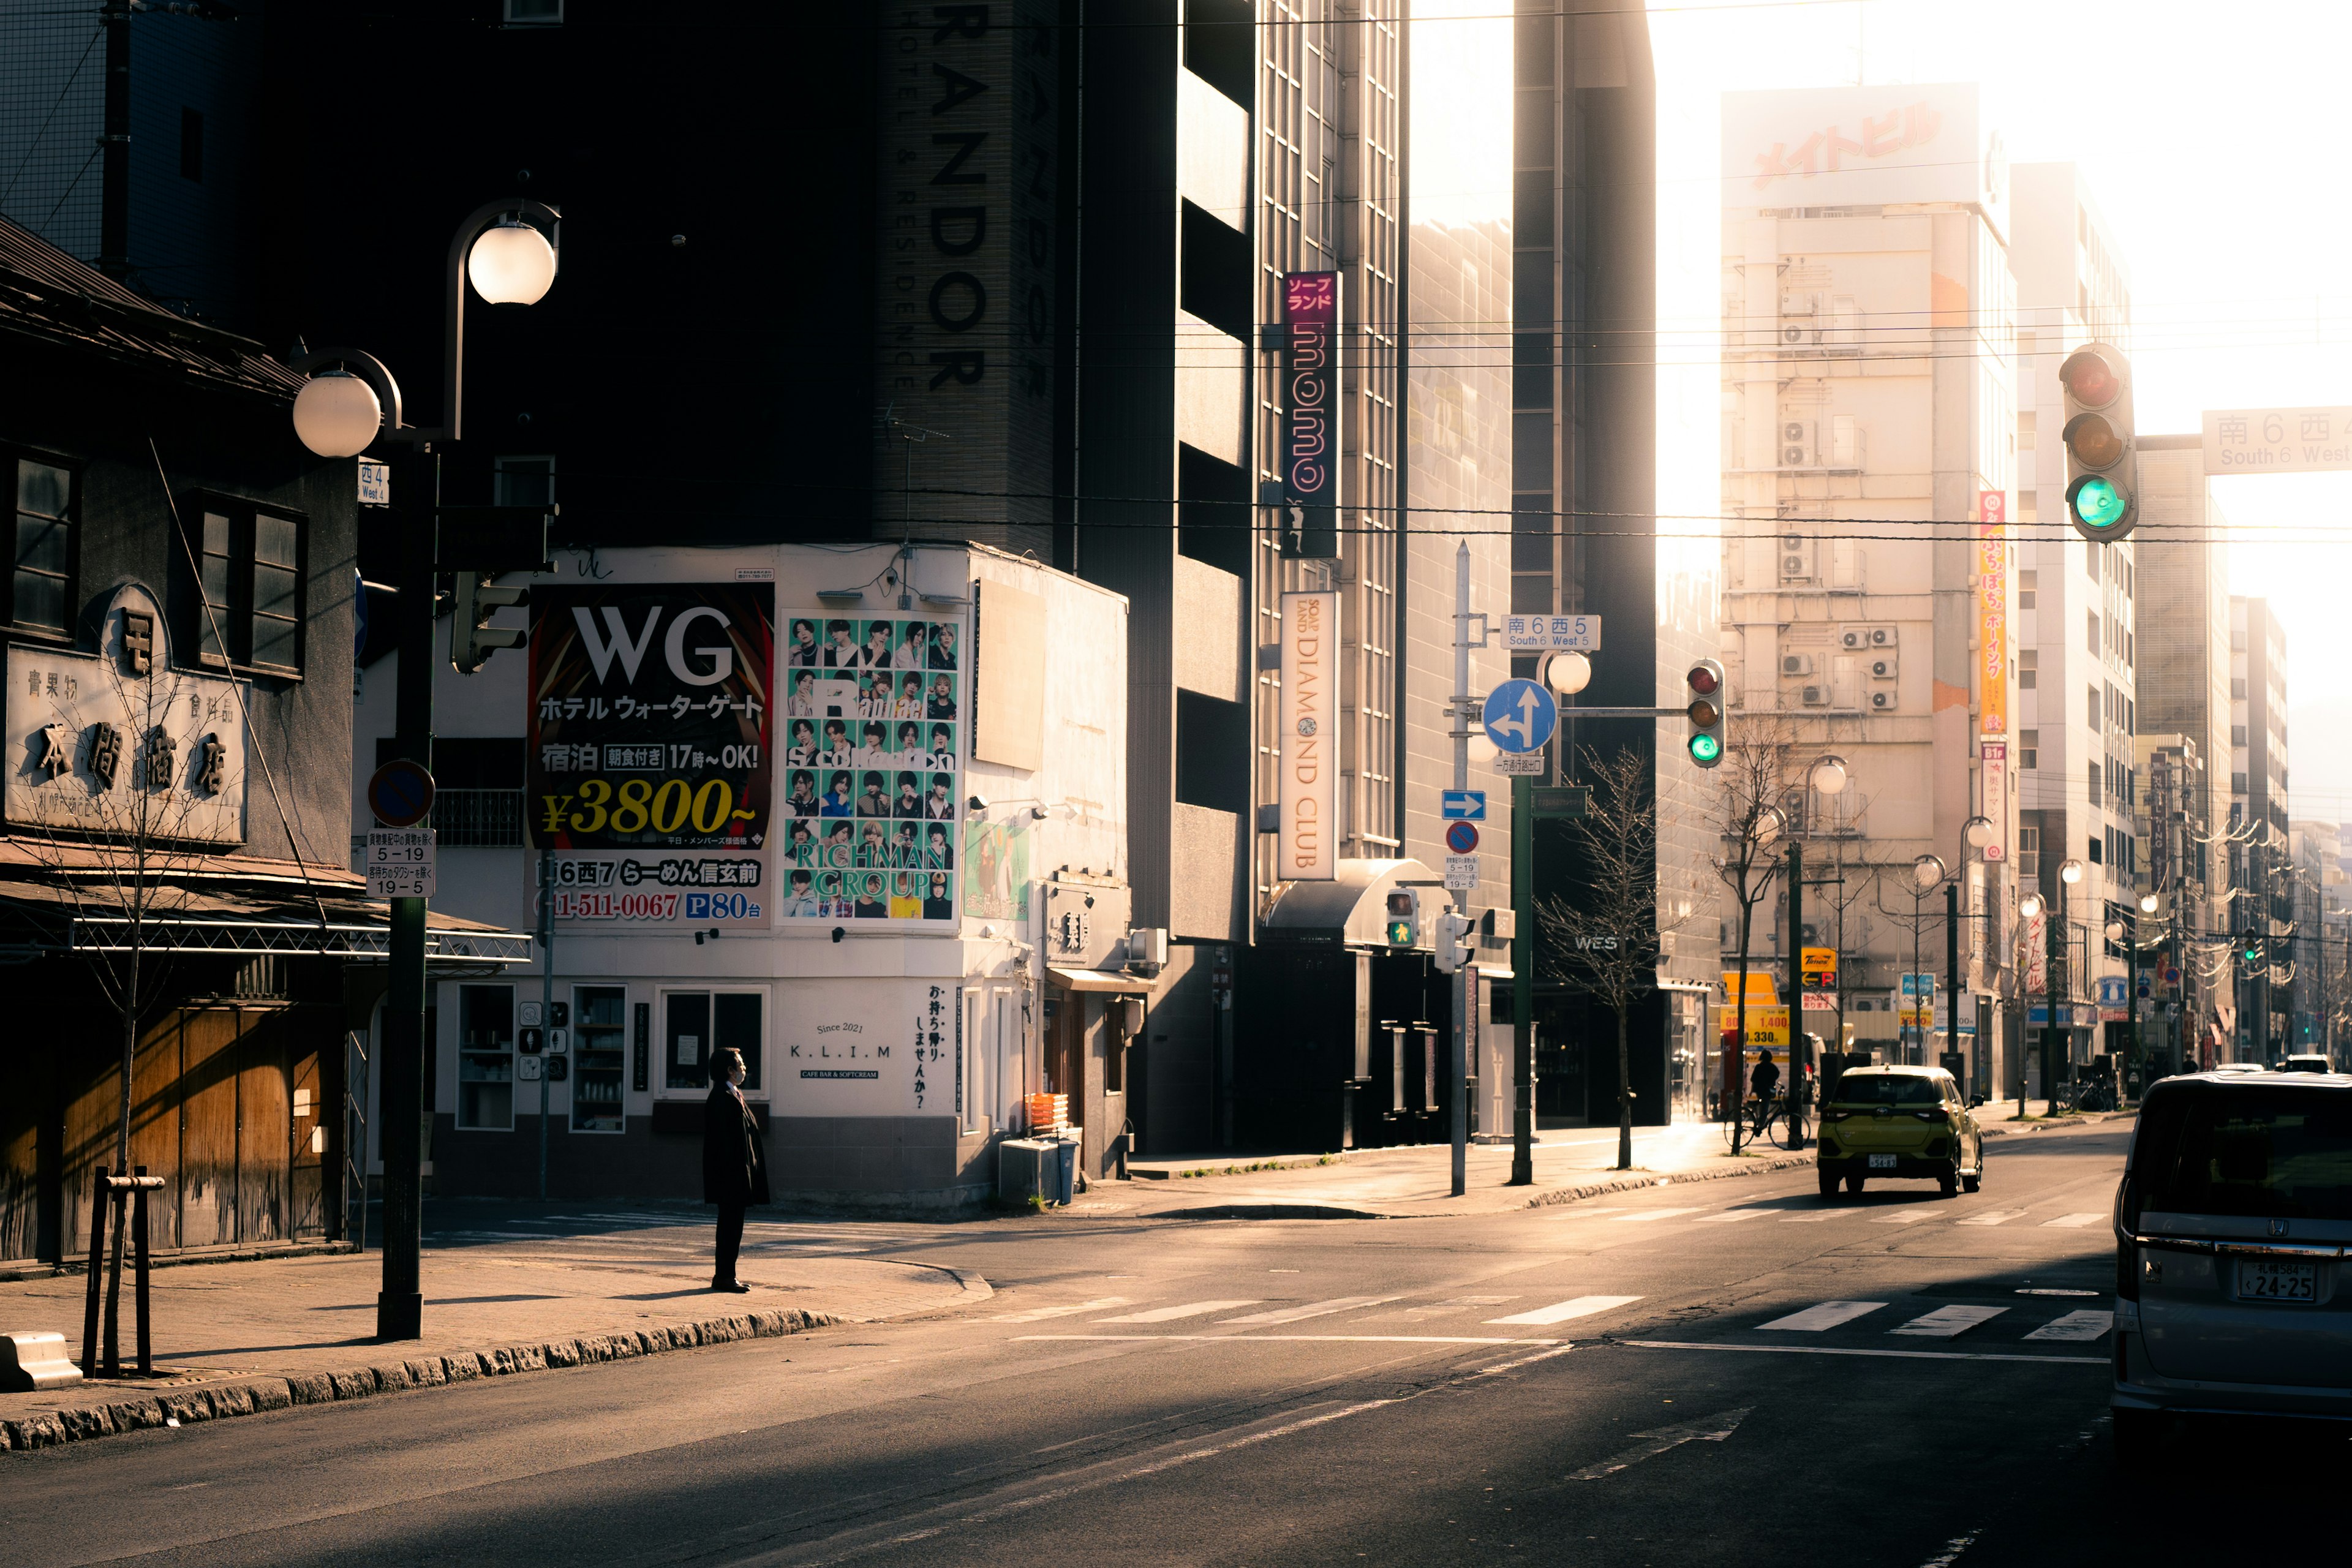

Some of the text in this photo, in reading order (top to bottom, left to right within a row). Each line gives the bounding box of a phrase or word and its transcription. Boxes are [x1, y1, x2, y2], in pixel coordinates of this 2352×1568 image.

[896, 10, 918, 123] HOTEL
[1752, 100, 1941, 190] メイトビル
[894, 190, 916, 390] RESIDENCE
[1289, 278, 1331, 293] ソープ
[1288, 295, 1331, 311] ランド
[1292, 322, 1325, 492] momo
[2221, 445, 2351, 466] South 6 West
[363, 486, 378, 499] West
[1296, 598, 1308, 633] LAND
[1308, 598, 1320, 631] SOAP
[571, 606, 733, 686] WG
[1509, 636, 1589, 646] South 6 West 5
[1986, 616, 2003, 677] ボーイング
[812, 679, 927, 725] Raphael
[542, 744, 597, 772] 宿泊
[609, 748, 661, 769] 朝食付き
[1496, 759, 1540, 772] 一方通行路出口
[369, 833, 432, 846] 貨物集配中の貨物を除く
[668, 836, 747, 846] 平日・メンバーズ様価格
[1294, 797, 1317, 869] CLUB
[796, 843, 945, 870] RICHMAN
[369, 867, 432, 880] 客待ちのタクシーを除く
[624, 861, 758, 884] らーめん信玄前
[814, 870, 930, 898] GROUP
[535, 894, 677, 918] 11-511-0067
[1804, 955, 1831, 966] Times
[1822, 973, 1834, 987] P
[817, 1022, 863, 1034] Since 2021
[929, 986, 940, 1061] お持ち帰り
